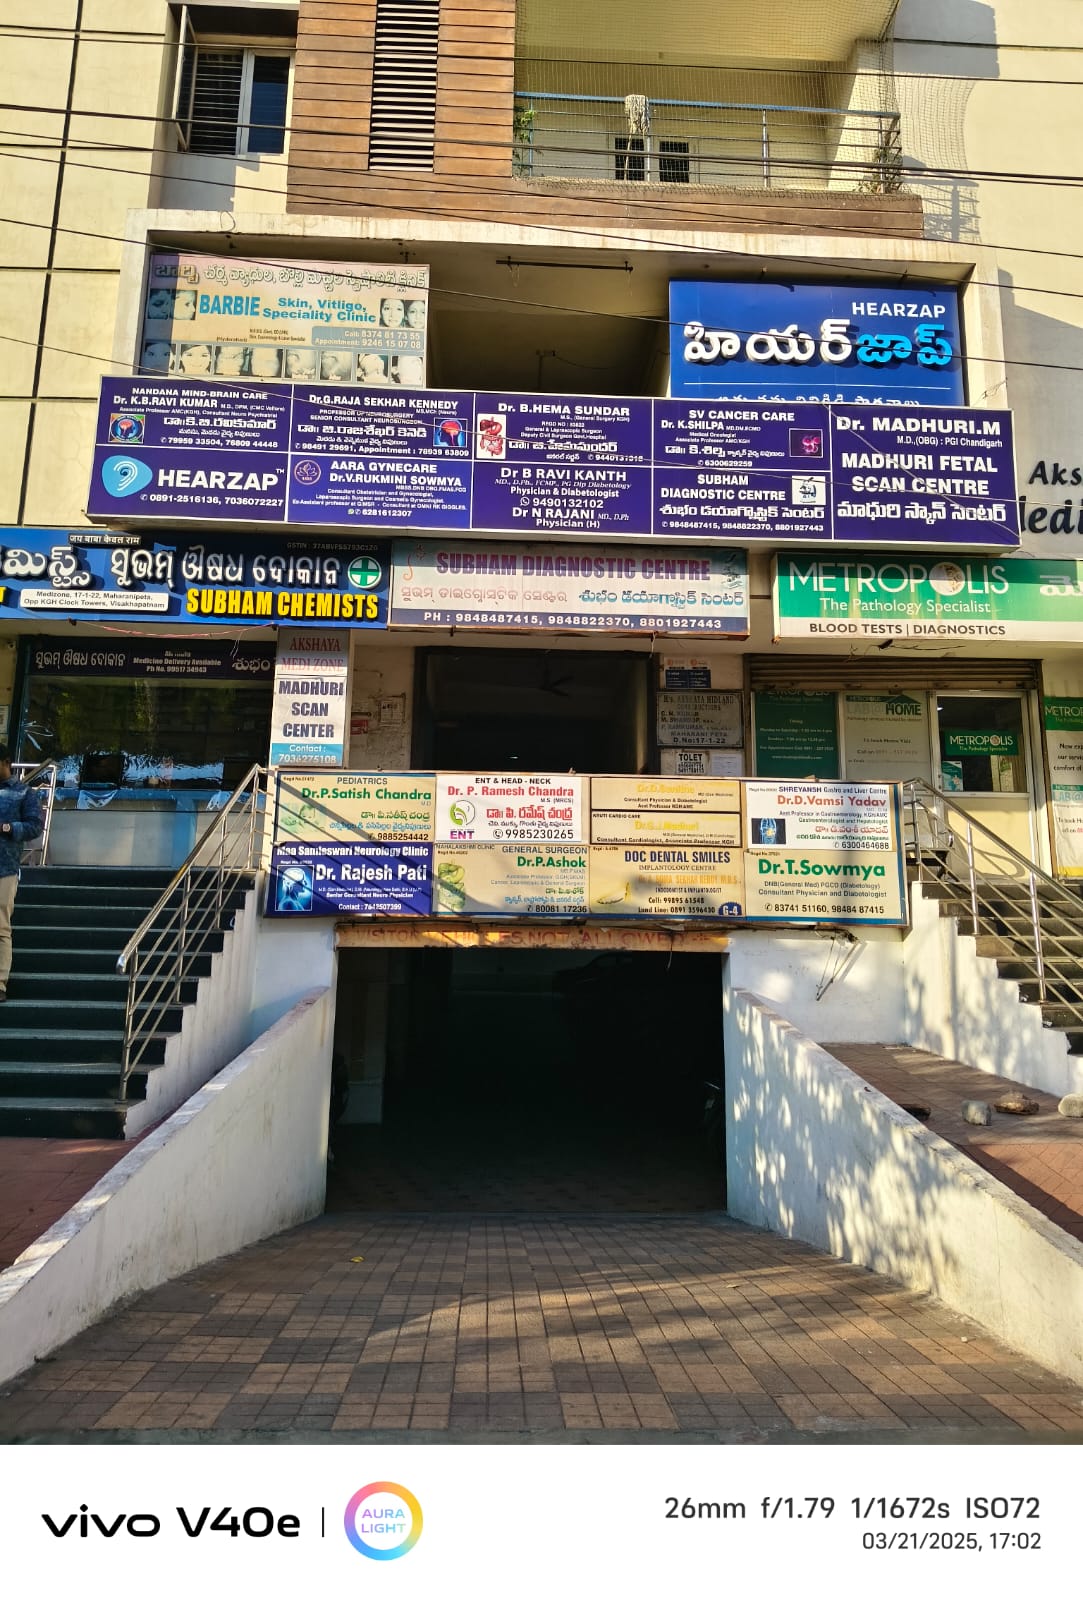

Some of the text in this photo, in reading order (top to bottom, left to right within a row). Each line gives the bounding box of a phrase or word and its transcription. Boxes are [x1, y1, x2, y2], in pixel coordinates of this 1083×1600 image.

[199, 294, 261, 316] BARBIE
[278, 297, 367, 313] Skin, Vitligo,
[852, 302, 946, 319] HEARZAP
[263, 308, 376, 322] Speciality Clinic
[132, 387, 268, 400] NANDANA MIND-BRAIN CARE
[113, 396, 218, 408] Dr. K.B.RAVI KUMAR
[309, 394, 459, 410] Dr.G.RAJA SEKHAR KENNEDY
[498, 403, 630, 417] Dr. B.HEMA SUNDAR
[688, 409, 795, 422] SV CANCER CARE
[661, 420, 725, 431] Dr. K.SHILPA
[836, 416, 1001, 435] Dr. MADHURI.M
[897, 435, 1003, 448] M.D.,(OBG) PGI Chandigarh
[330, 460, 438, 473] AARA GYNECARE
[841, 452, 999, 473] MADHURI FETAL
[157, 469, 279, 491] HEARZAP
[329, 473, 462, 487] Dr.V.RUKMINI SOWMYA
[500, 467, 627, 482] Dr B RAVI KANTH
[697, 474, 749, 486] SUBHAM
[510, 485, 620, 499] Physician & Diabetologist
[851, 476, 990, 496] SCAN CENTRE
[660, 487, 786, 501] DIAGNOSTIC CENTRE
[224, 496, 284, 507] 7036072227
[532, 499, 605, 509] 9490132102
[535, 518, 601, 529] Physician (H)
[69, 534, 83, 543] जय
[84, 535, 102, 544] बाबा
[125, 536, 140, 545] राम
[436, 551, 711, 582] SUBHAM DIAGNOSTIC CENTRE
[789, 560, 1009, 596] METROPOLIS
[36, 591, 153, 601] Medizone, 17-1-22, Maharanipeta,
[23, 598, 39, 607] Opp
[58, 599, 80, 607] Clock
[80, 599, 108, 608] Towers,
[110, 600, 165, 609] Visakhapatnam
[186, 588, 379, 619] SUBHAM CHEMISTS
[819, 598, 991, 616] The Pathology Specialist
[424, 612, 722, 629] PH 9848487415, 9848822370, 8801927443
[809, 623, 1006, 636] BLOOD TESTS DIAGNOSTICS
[289, 637, 341, 652] AKSHAYA
[164, 658, 191, 667] Delivery
[281, 657, 344, 672] MEDI ZONE
[278, 681, 344, 696] MADHURI
[291, 702, 329, 717] SCAN
[886, 703, 922, 716] HOME
[282, 723, 335, 738] CENTER
[949, 735, 1014, 746] METROPOLIS
[289, 744, 323, 753] Contact
[678, 753, 703, 761] TOLET
[336, 777, 388, 785] PEDIATRICS
[301, 787, 432, 800] Dr.P.Satish Chandra
[447, 786, 574, 797] Dr. P. Ramesh Chandra
[823, 786, 842, 794] Gastro
[777, 795, 887, 807] Dr.D.Vamsi Yadav
[377, 833, 429, 841] 9885254442
[450, 830, 475, 840] ENT
[505, 829, 574, 839] 9985230265
[501, 846, 543, 854] GENERAL
[545, 846, 588, 855] SURGEON
[624, 850, 731, 864] DOC DENTAL SMILES
[516, 855, 587, 868] Dr.P.Ashok
[690, 864, 716, 872] CENTRE
[315, 864, 427, 884] Dr. Rajesh Pati
[758, 858, 886, 881] Dr.T.Sowmya
[758, 888, 795, 896] Consultant
[796, 889, 828, 897] Physician
[843, 890, 887, 898] Diabetologist
[722, 905, 739, 916] G-4
[774, 903, 885, 914] 83741 51160, 98484 87415
